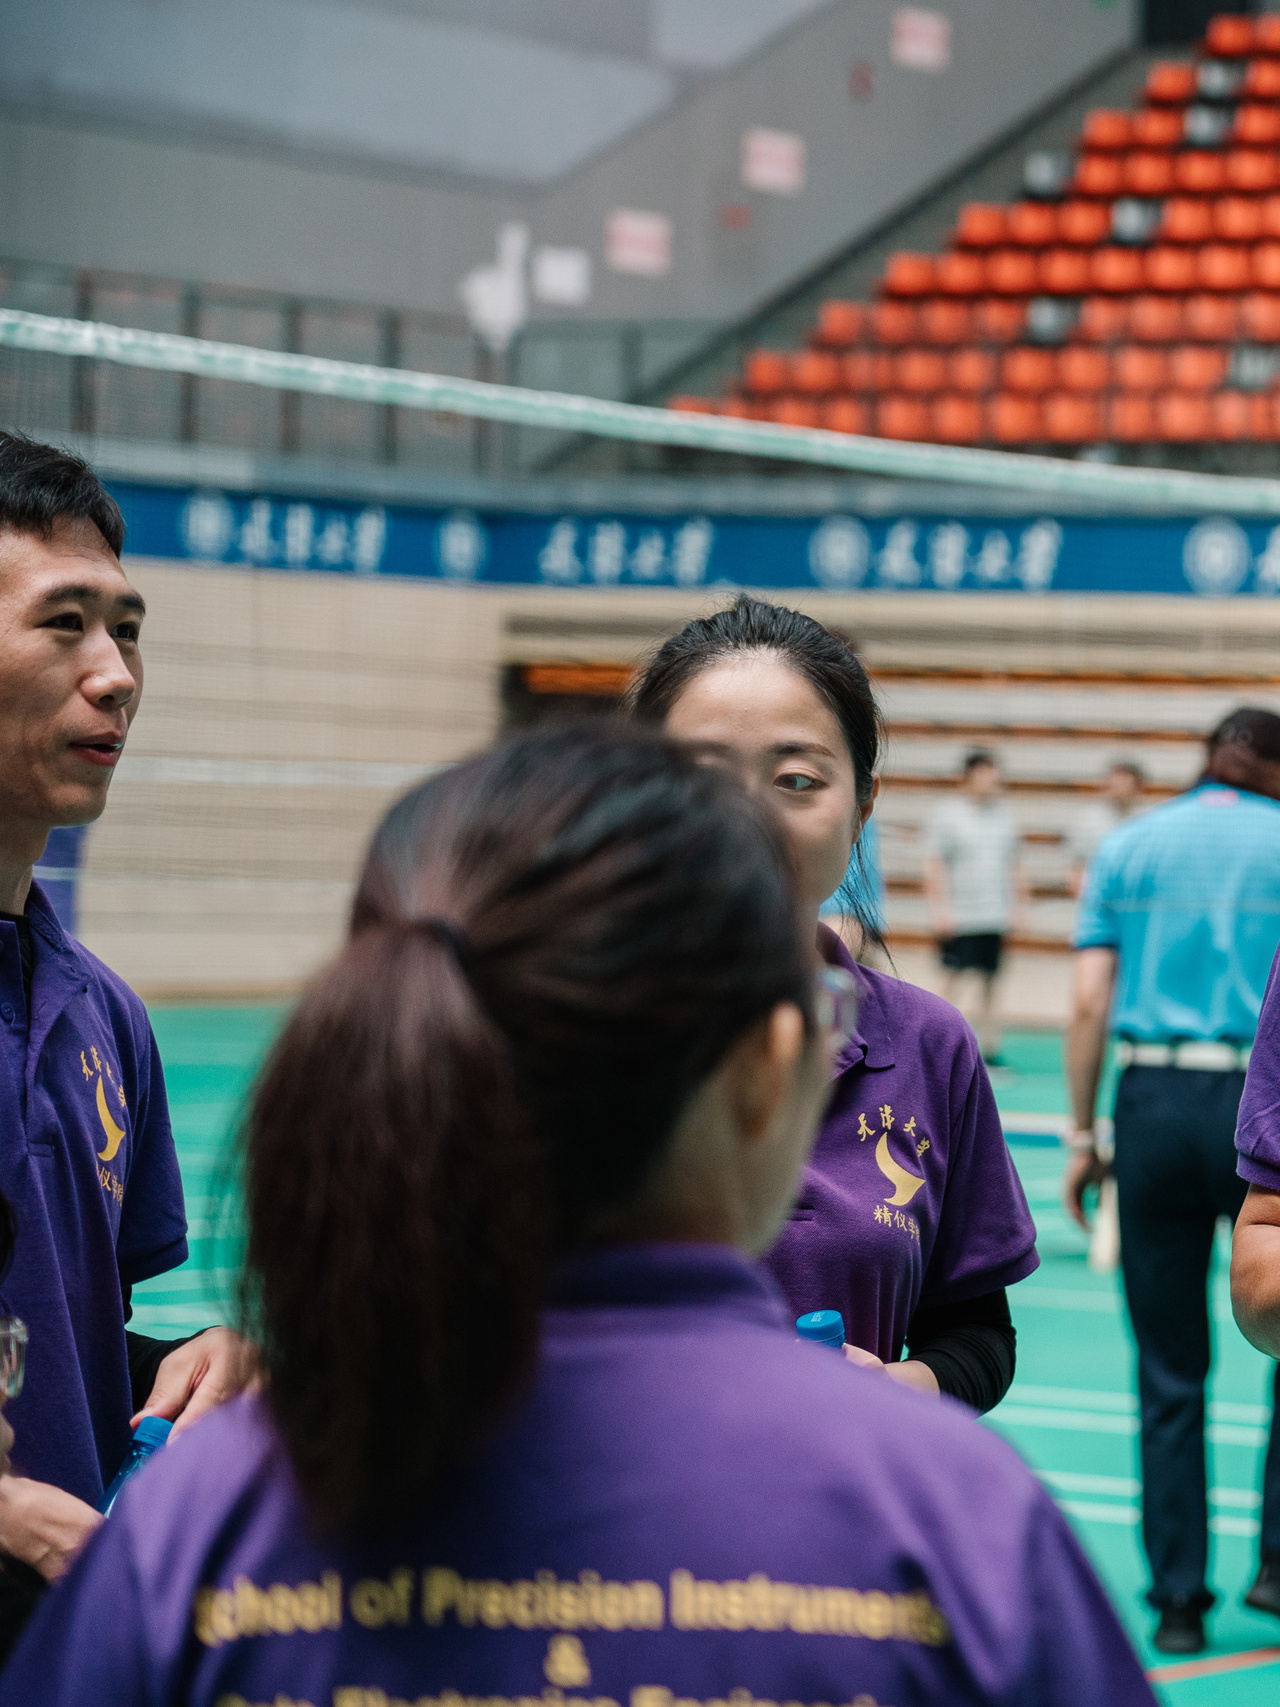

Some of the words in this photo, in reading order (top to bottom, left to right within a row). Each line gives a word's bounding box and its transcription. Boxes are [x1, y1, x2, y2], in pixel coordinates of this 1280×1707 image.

[857, 1104, 931, 1158] 天津大学
[350, 1565, 414, 1630] of
[421, 1565, 665, 1632] Precision
[542, 1632, 592, 1688] &
